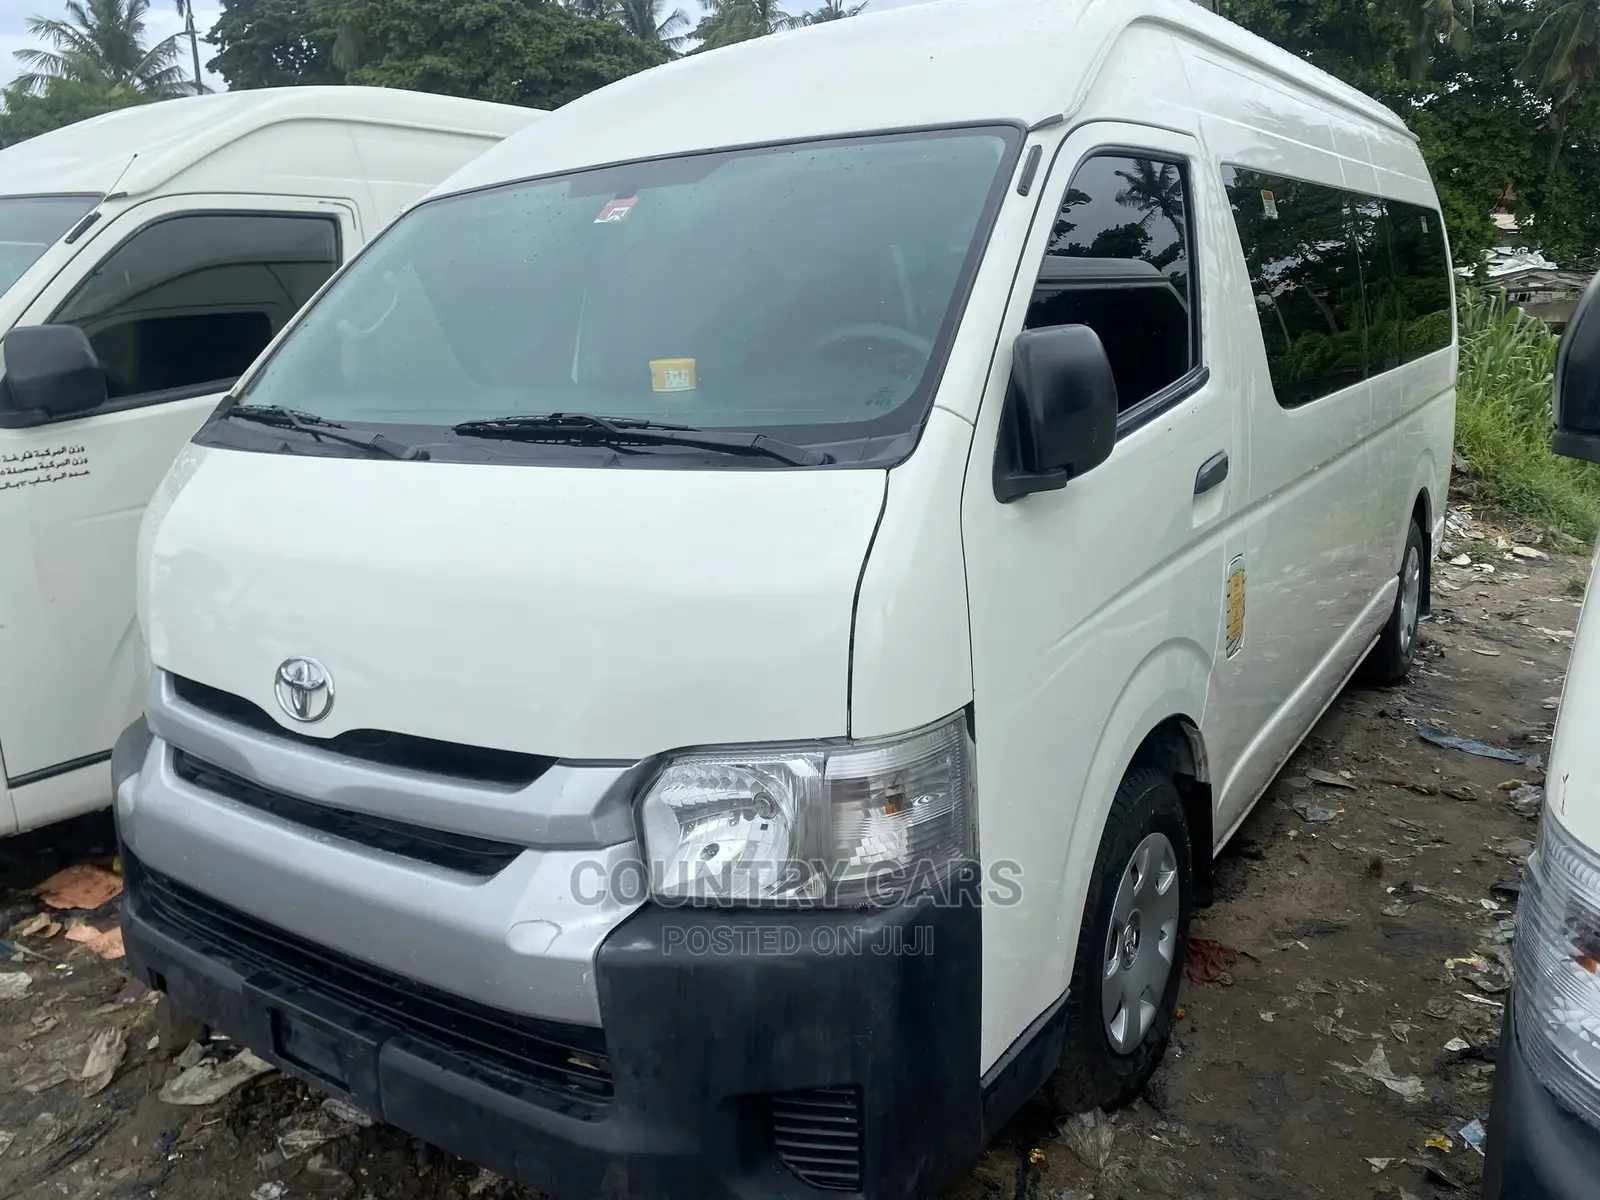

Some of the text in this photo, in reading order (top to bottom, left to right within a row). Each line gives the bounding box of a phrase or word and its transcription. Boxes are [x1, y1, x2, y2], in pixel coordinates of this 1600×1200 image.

[2, 445, 85, 462] وزن المركبة فارغة
[38, 458, 71, 471] المركبة
[72, 457, 88, 466] وزن
[28, 472, 67, 487] الركاب
[68, 470, 91, 478] عدد
